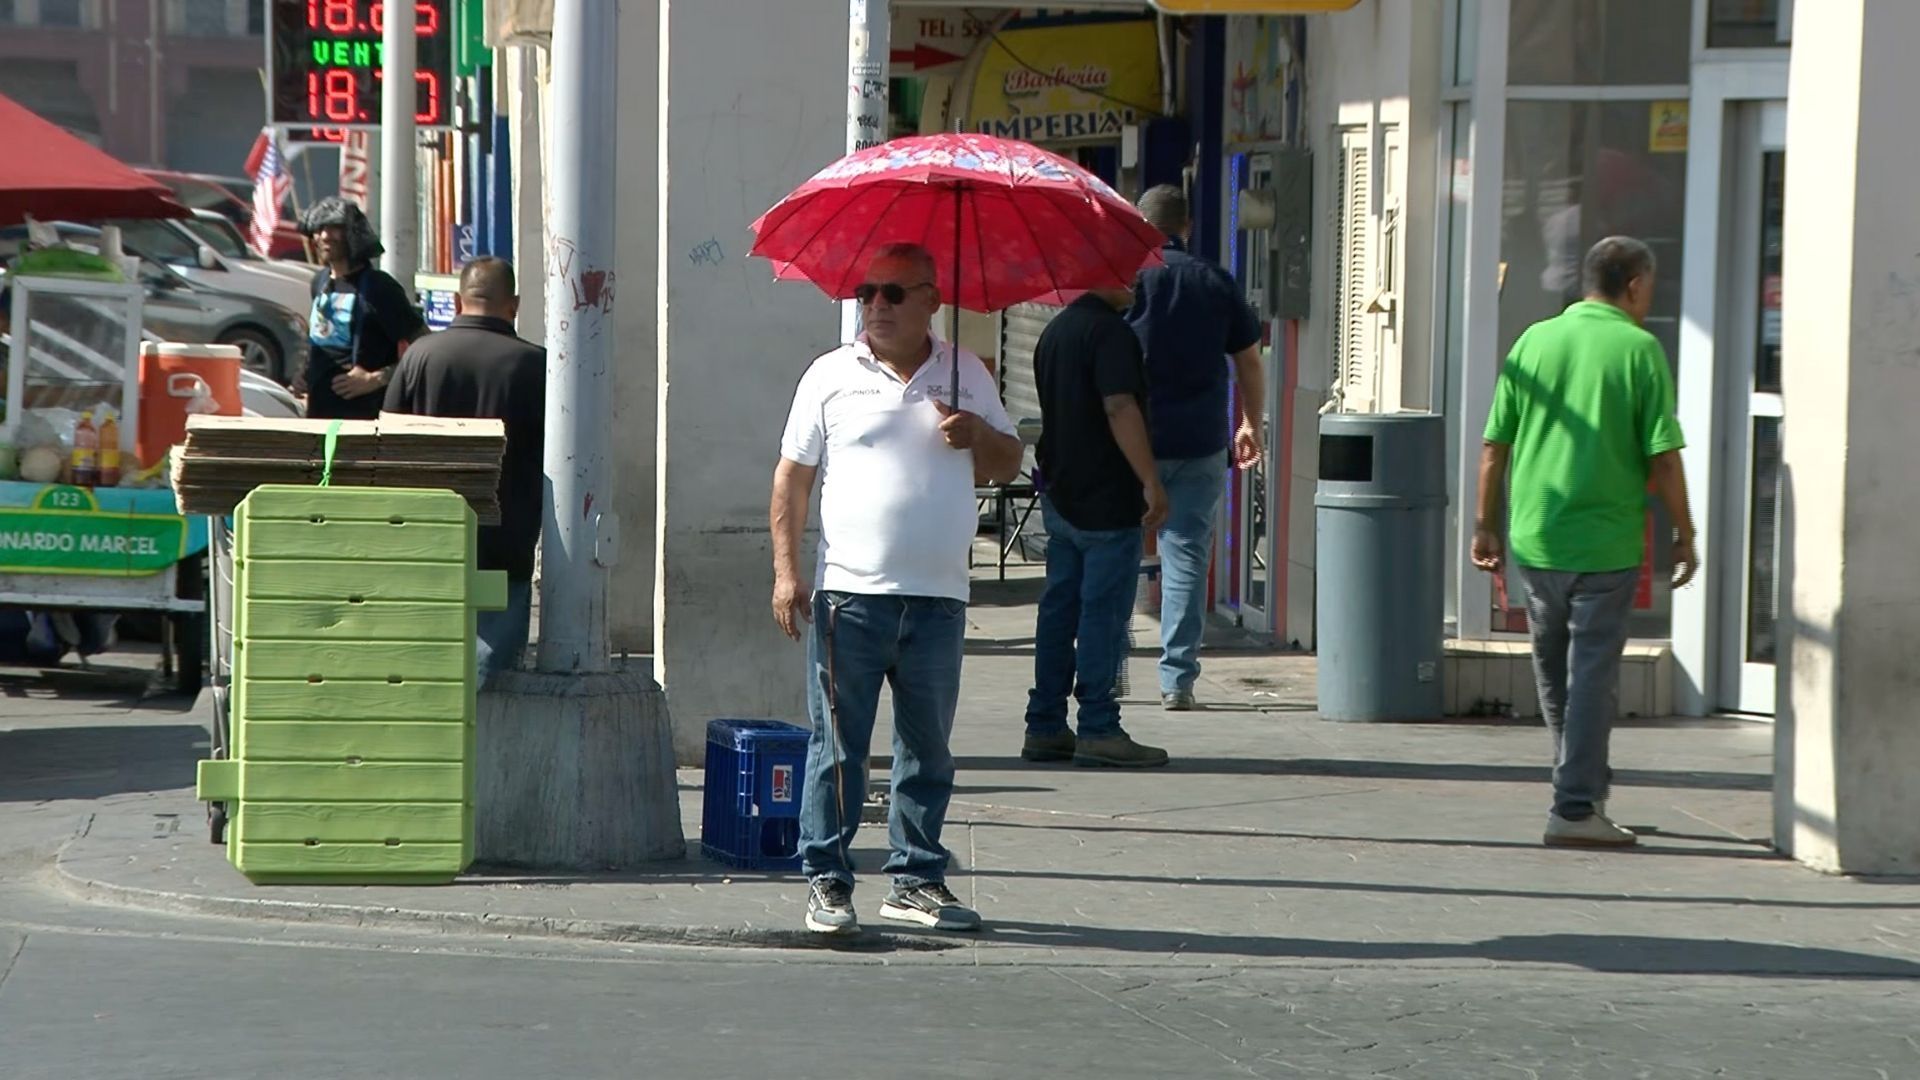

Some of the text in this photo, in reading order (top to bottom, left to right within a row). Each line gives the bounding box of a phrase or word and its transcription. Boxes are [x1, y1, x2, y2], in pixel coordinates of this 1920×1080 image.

[308, 69, 439, 122] 18.0
[52, 492, 81, 507] 123
[0, 531, 159, 555] NARDO MARCEL
